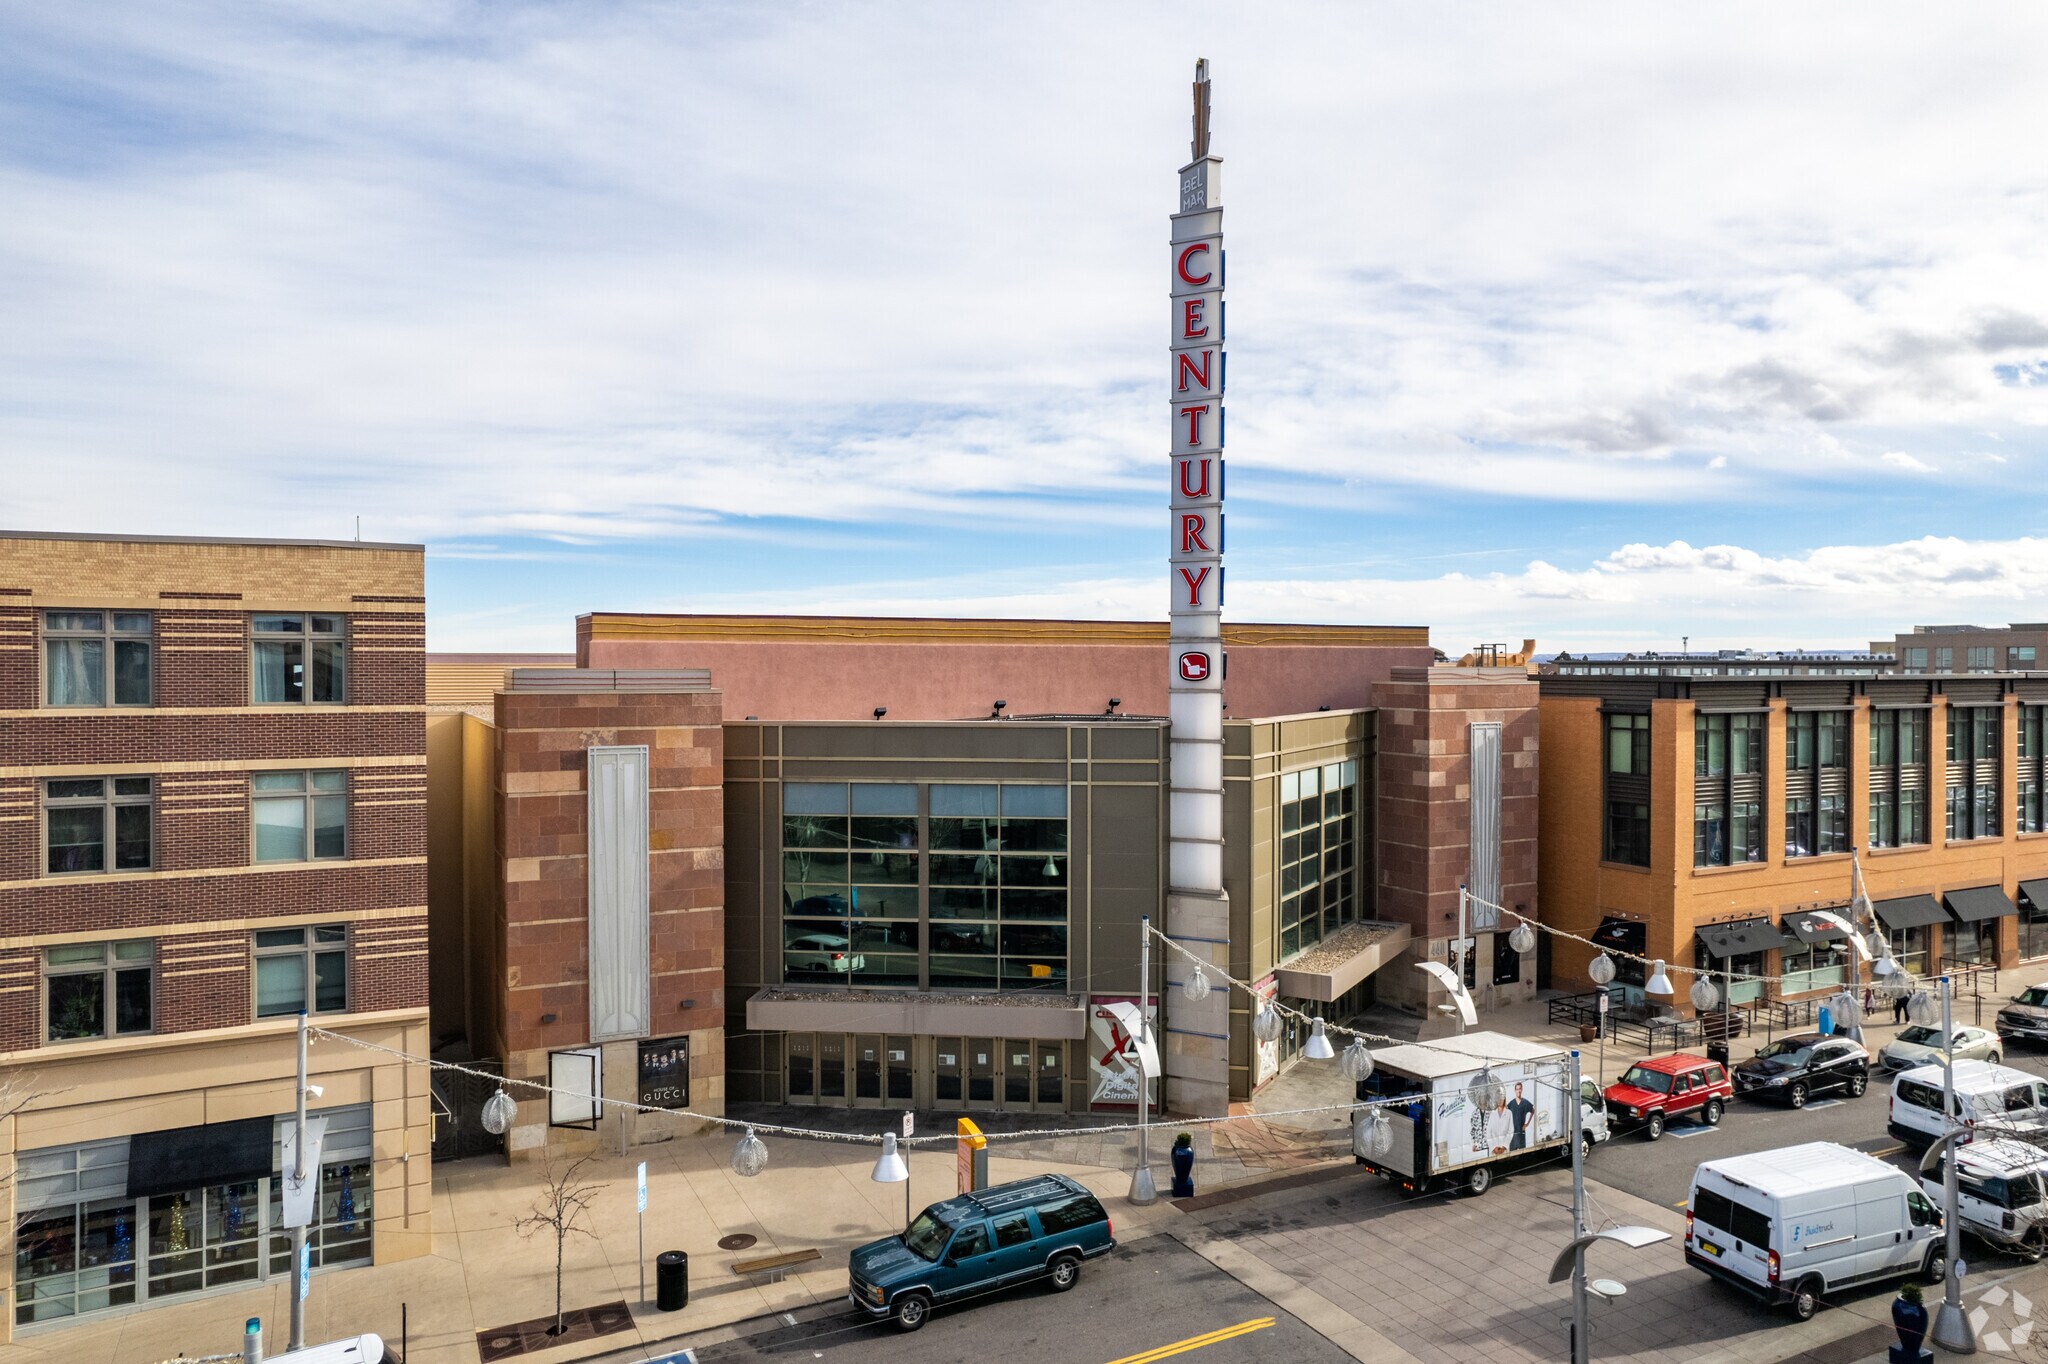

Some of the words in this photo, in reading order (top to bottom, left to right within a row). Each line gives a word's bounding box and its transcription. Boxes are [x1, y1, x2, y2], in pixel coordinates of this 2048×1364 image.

[1181, 167, 1203, 194] BEL
[1183, 190, 1205, 211] MAR
[1178, 243, 1213, 606] CENTURY
[1101, 1070, 1138, 1080] Extrem
[1105, 1081, 1138, 1091] Digita
[643, 1089, 685, 1102] GUCCI
[1103, 1091, 1138, 1100] Cinem
